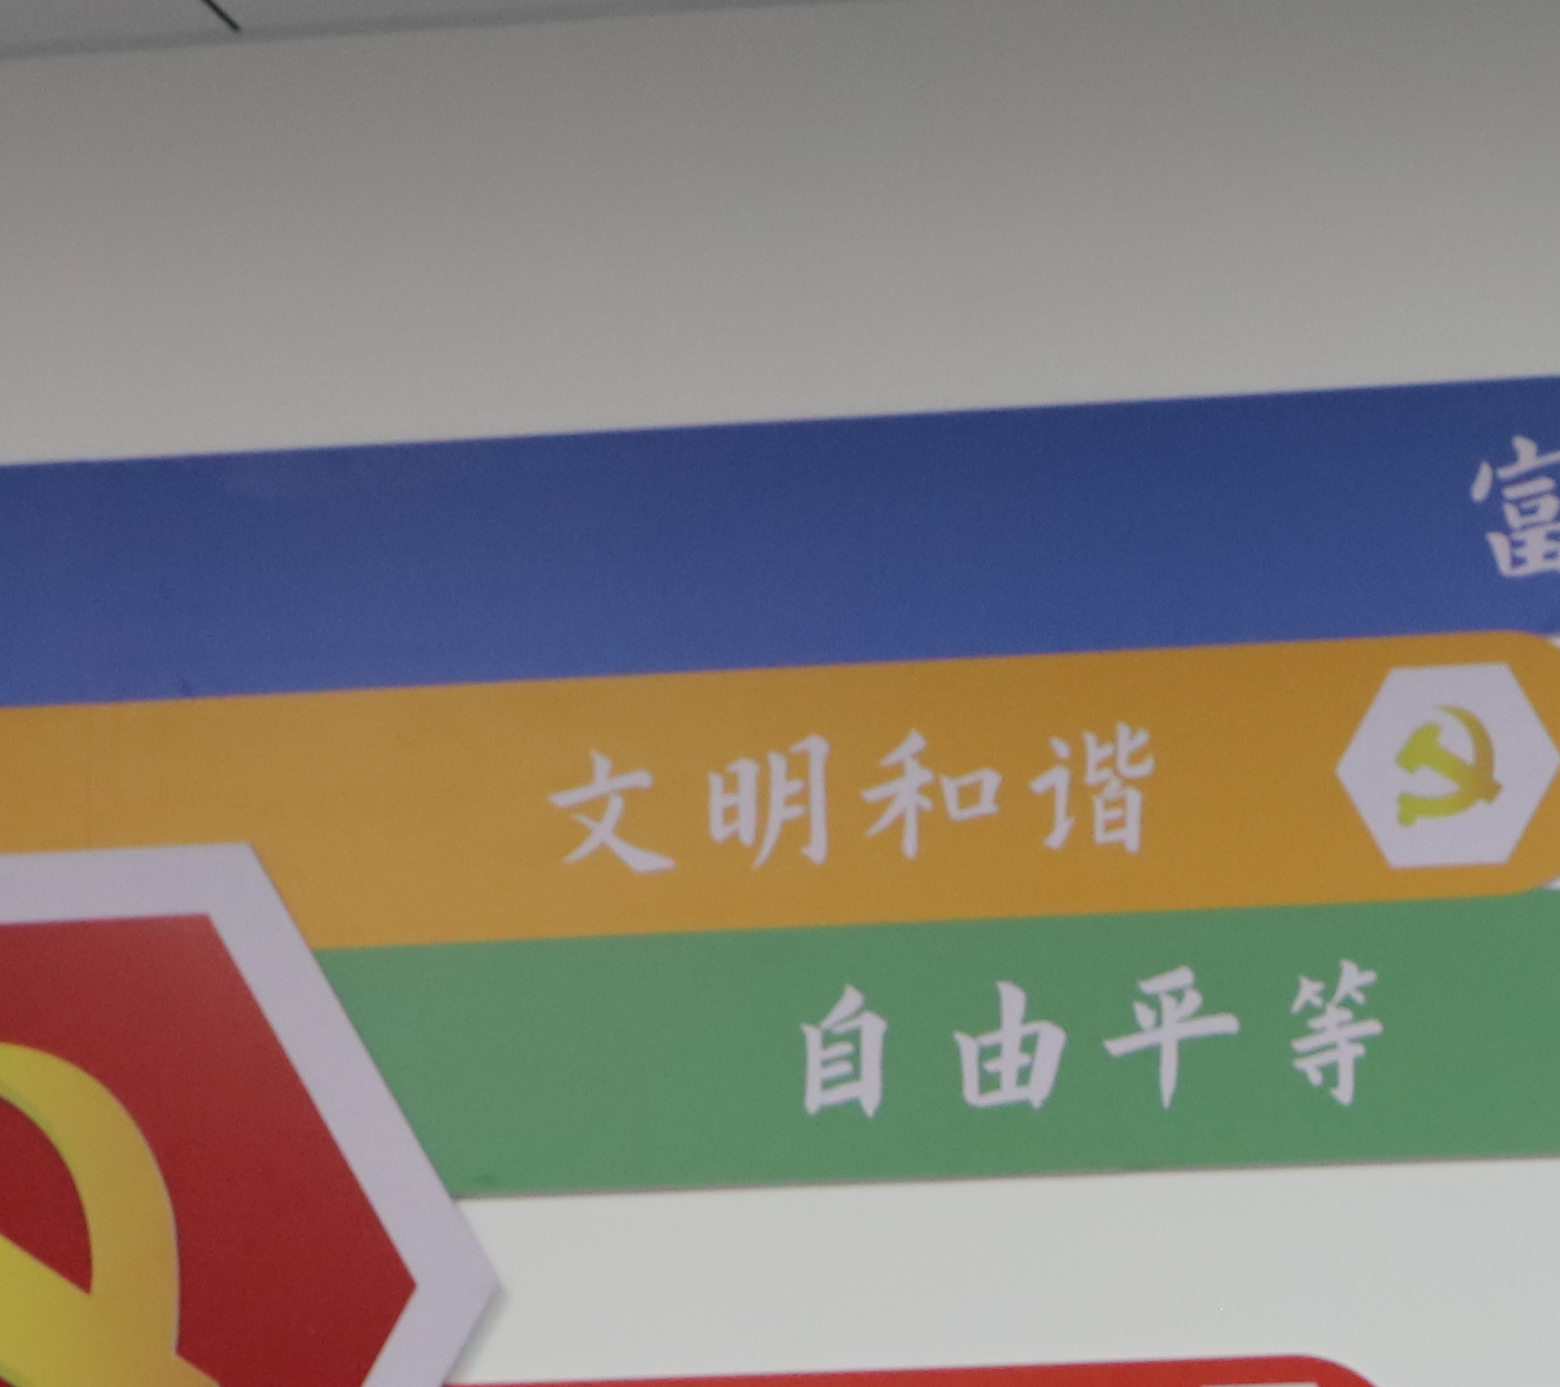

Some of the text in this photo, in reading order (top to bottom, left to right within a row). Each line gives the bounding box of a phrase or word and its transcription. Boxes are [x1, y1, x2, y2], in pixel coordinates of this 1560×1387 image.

[545, 720, 1159, 880] 文明和谐
[796, 958, 1388, 1122] 自由平等
